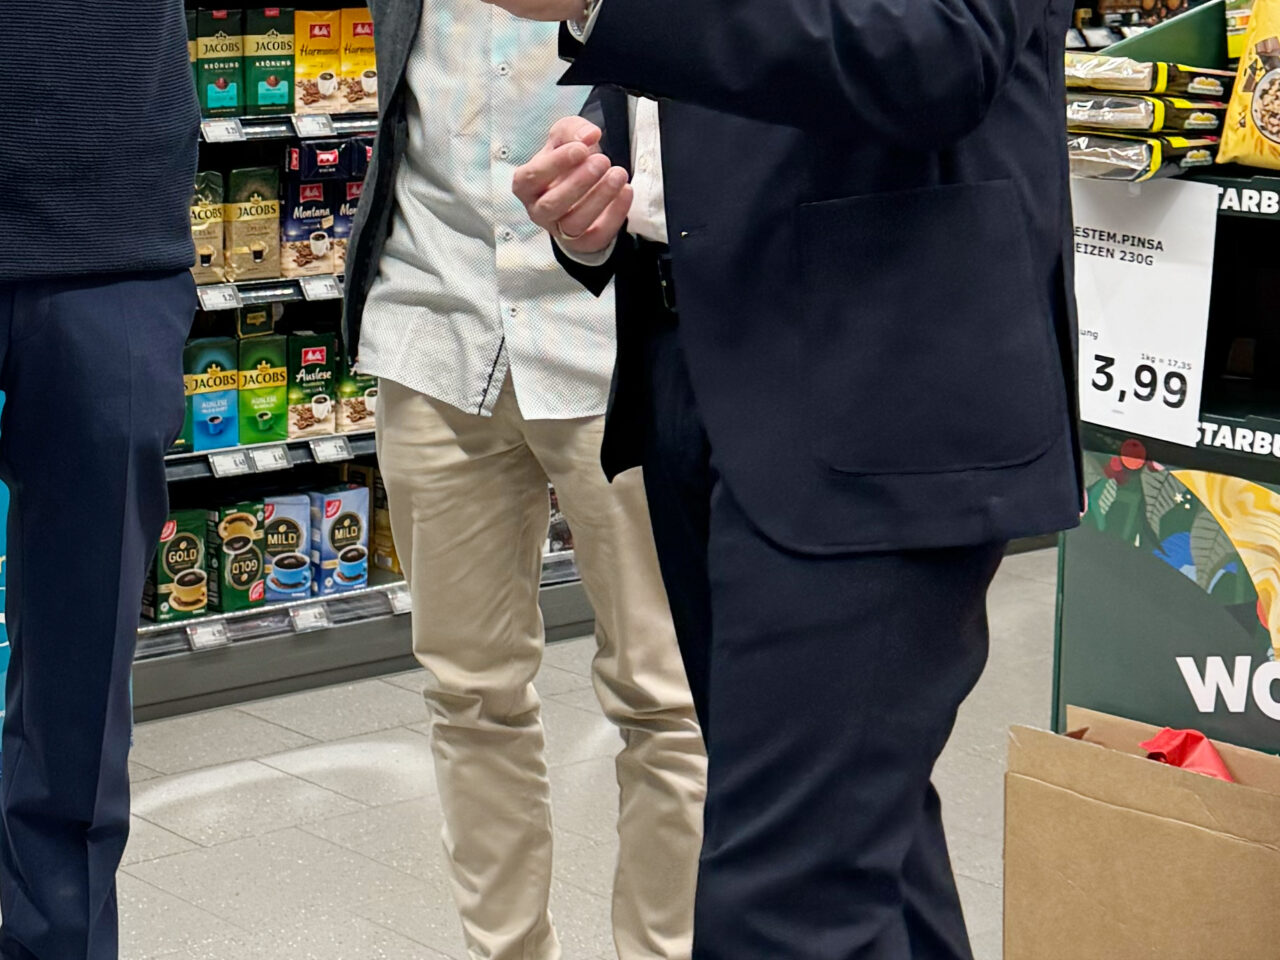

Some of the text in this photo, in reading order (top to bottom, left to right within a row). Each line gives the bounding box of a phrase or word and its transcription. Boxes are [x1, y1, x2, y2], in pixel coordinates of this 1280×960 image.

[203, 42, 240, 55] JACOBS
[255, 40, 292, 52] JACOBS
[237, 204, 277, 219] JACOBS
[293, 206, 330, 220] Montana
[1074, 226, 1164, 252] ESTEM.PINSA
[1075, 242, 1154, 266] EIZEN 230G
[243, 371, 286, 387] JACOBS
[296, 367, 332, 382] Auslese
[1091, 353, 1188, 409] 3,99
[193, 374, 236, 391] JACOBS
[267, 533, 297, 545] MILD
[335, 526, 358, 539] MILD
[168, 548, 197, 563] GOLD
[232, 559, 258, 574] GOLD
